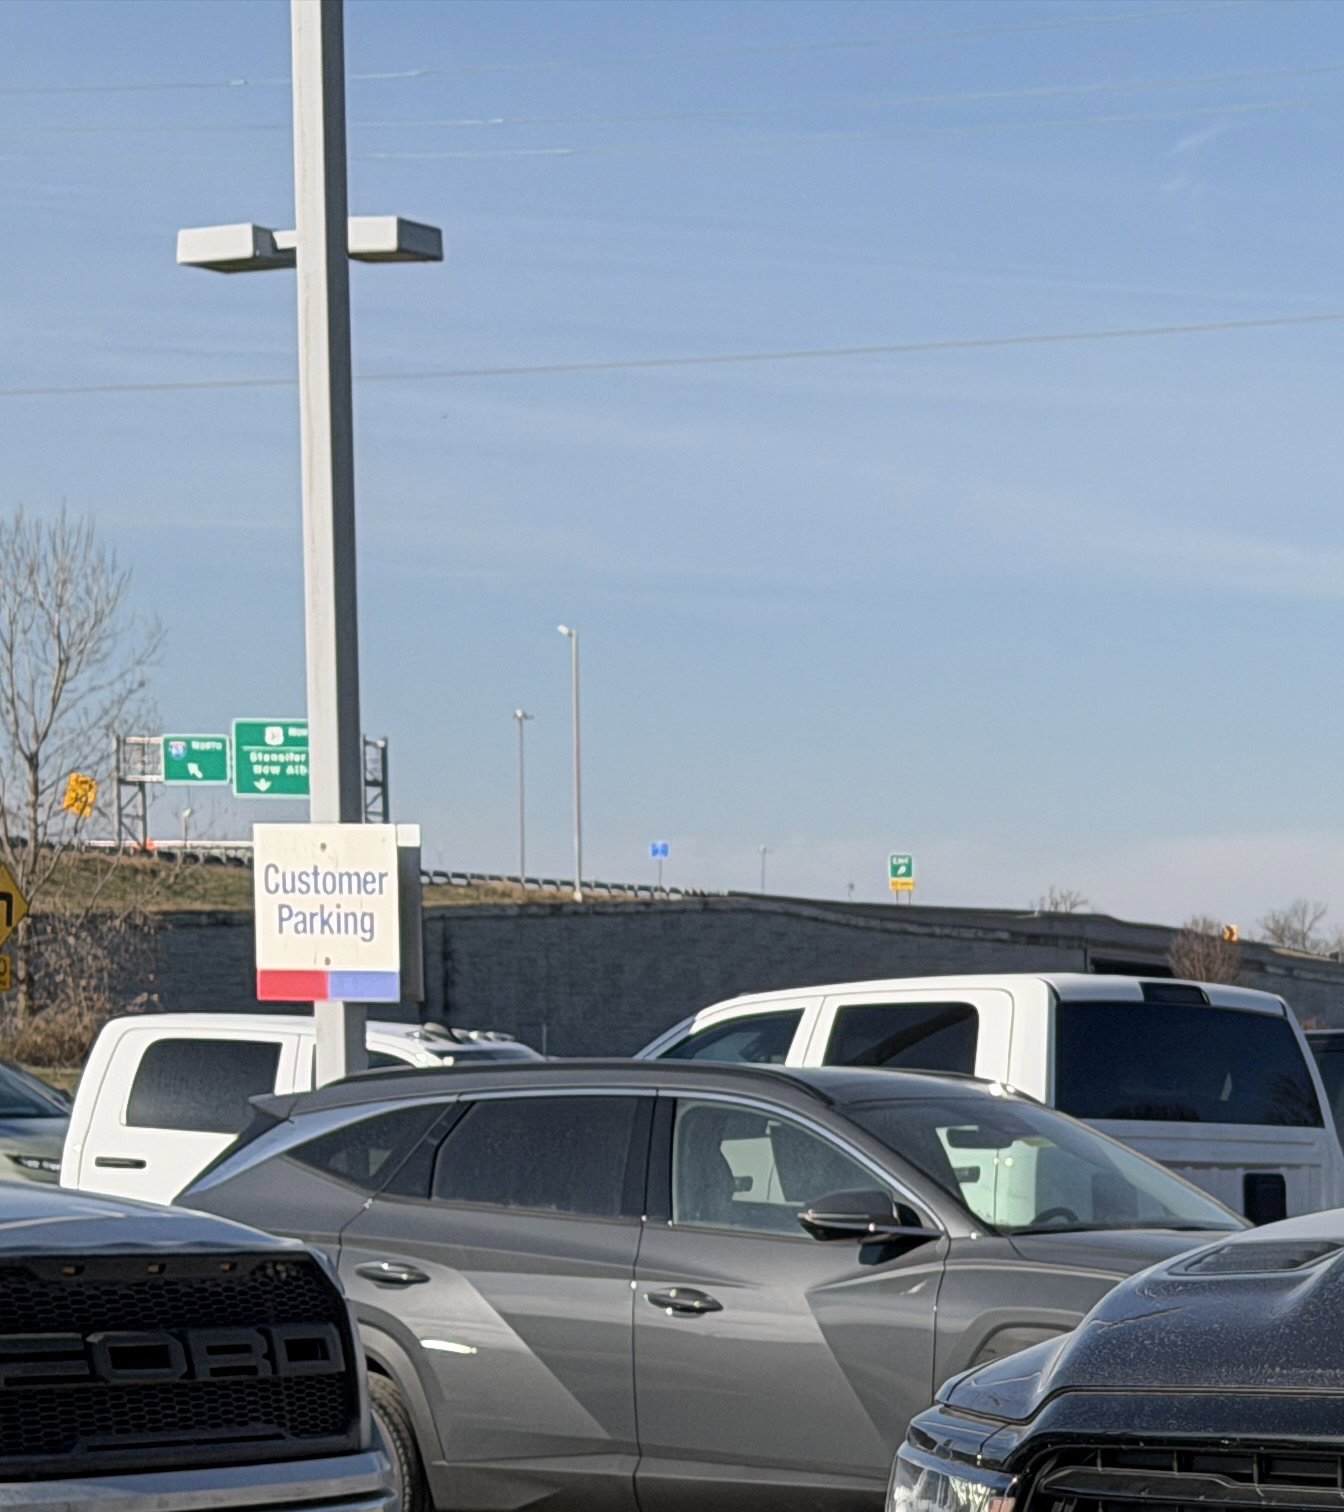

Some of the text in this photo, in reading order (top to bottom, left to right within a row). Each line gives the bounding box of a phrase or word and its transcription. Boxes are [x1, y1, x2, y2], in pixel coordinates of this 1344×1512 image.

[263, 863, 389, 896] Customer
[277, 902, 376, 943] Parking
[0, 1322, 346, 1385] FORD
